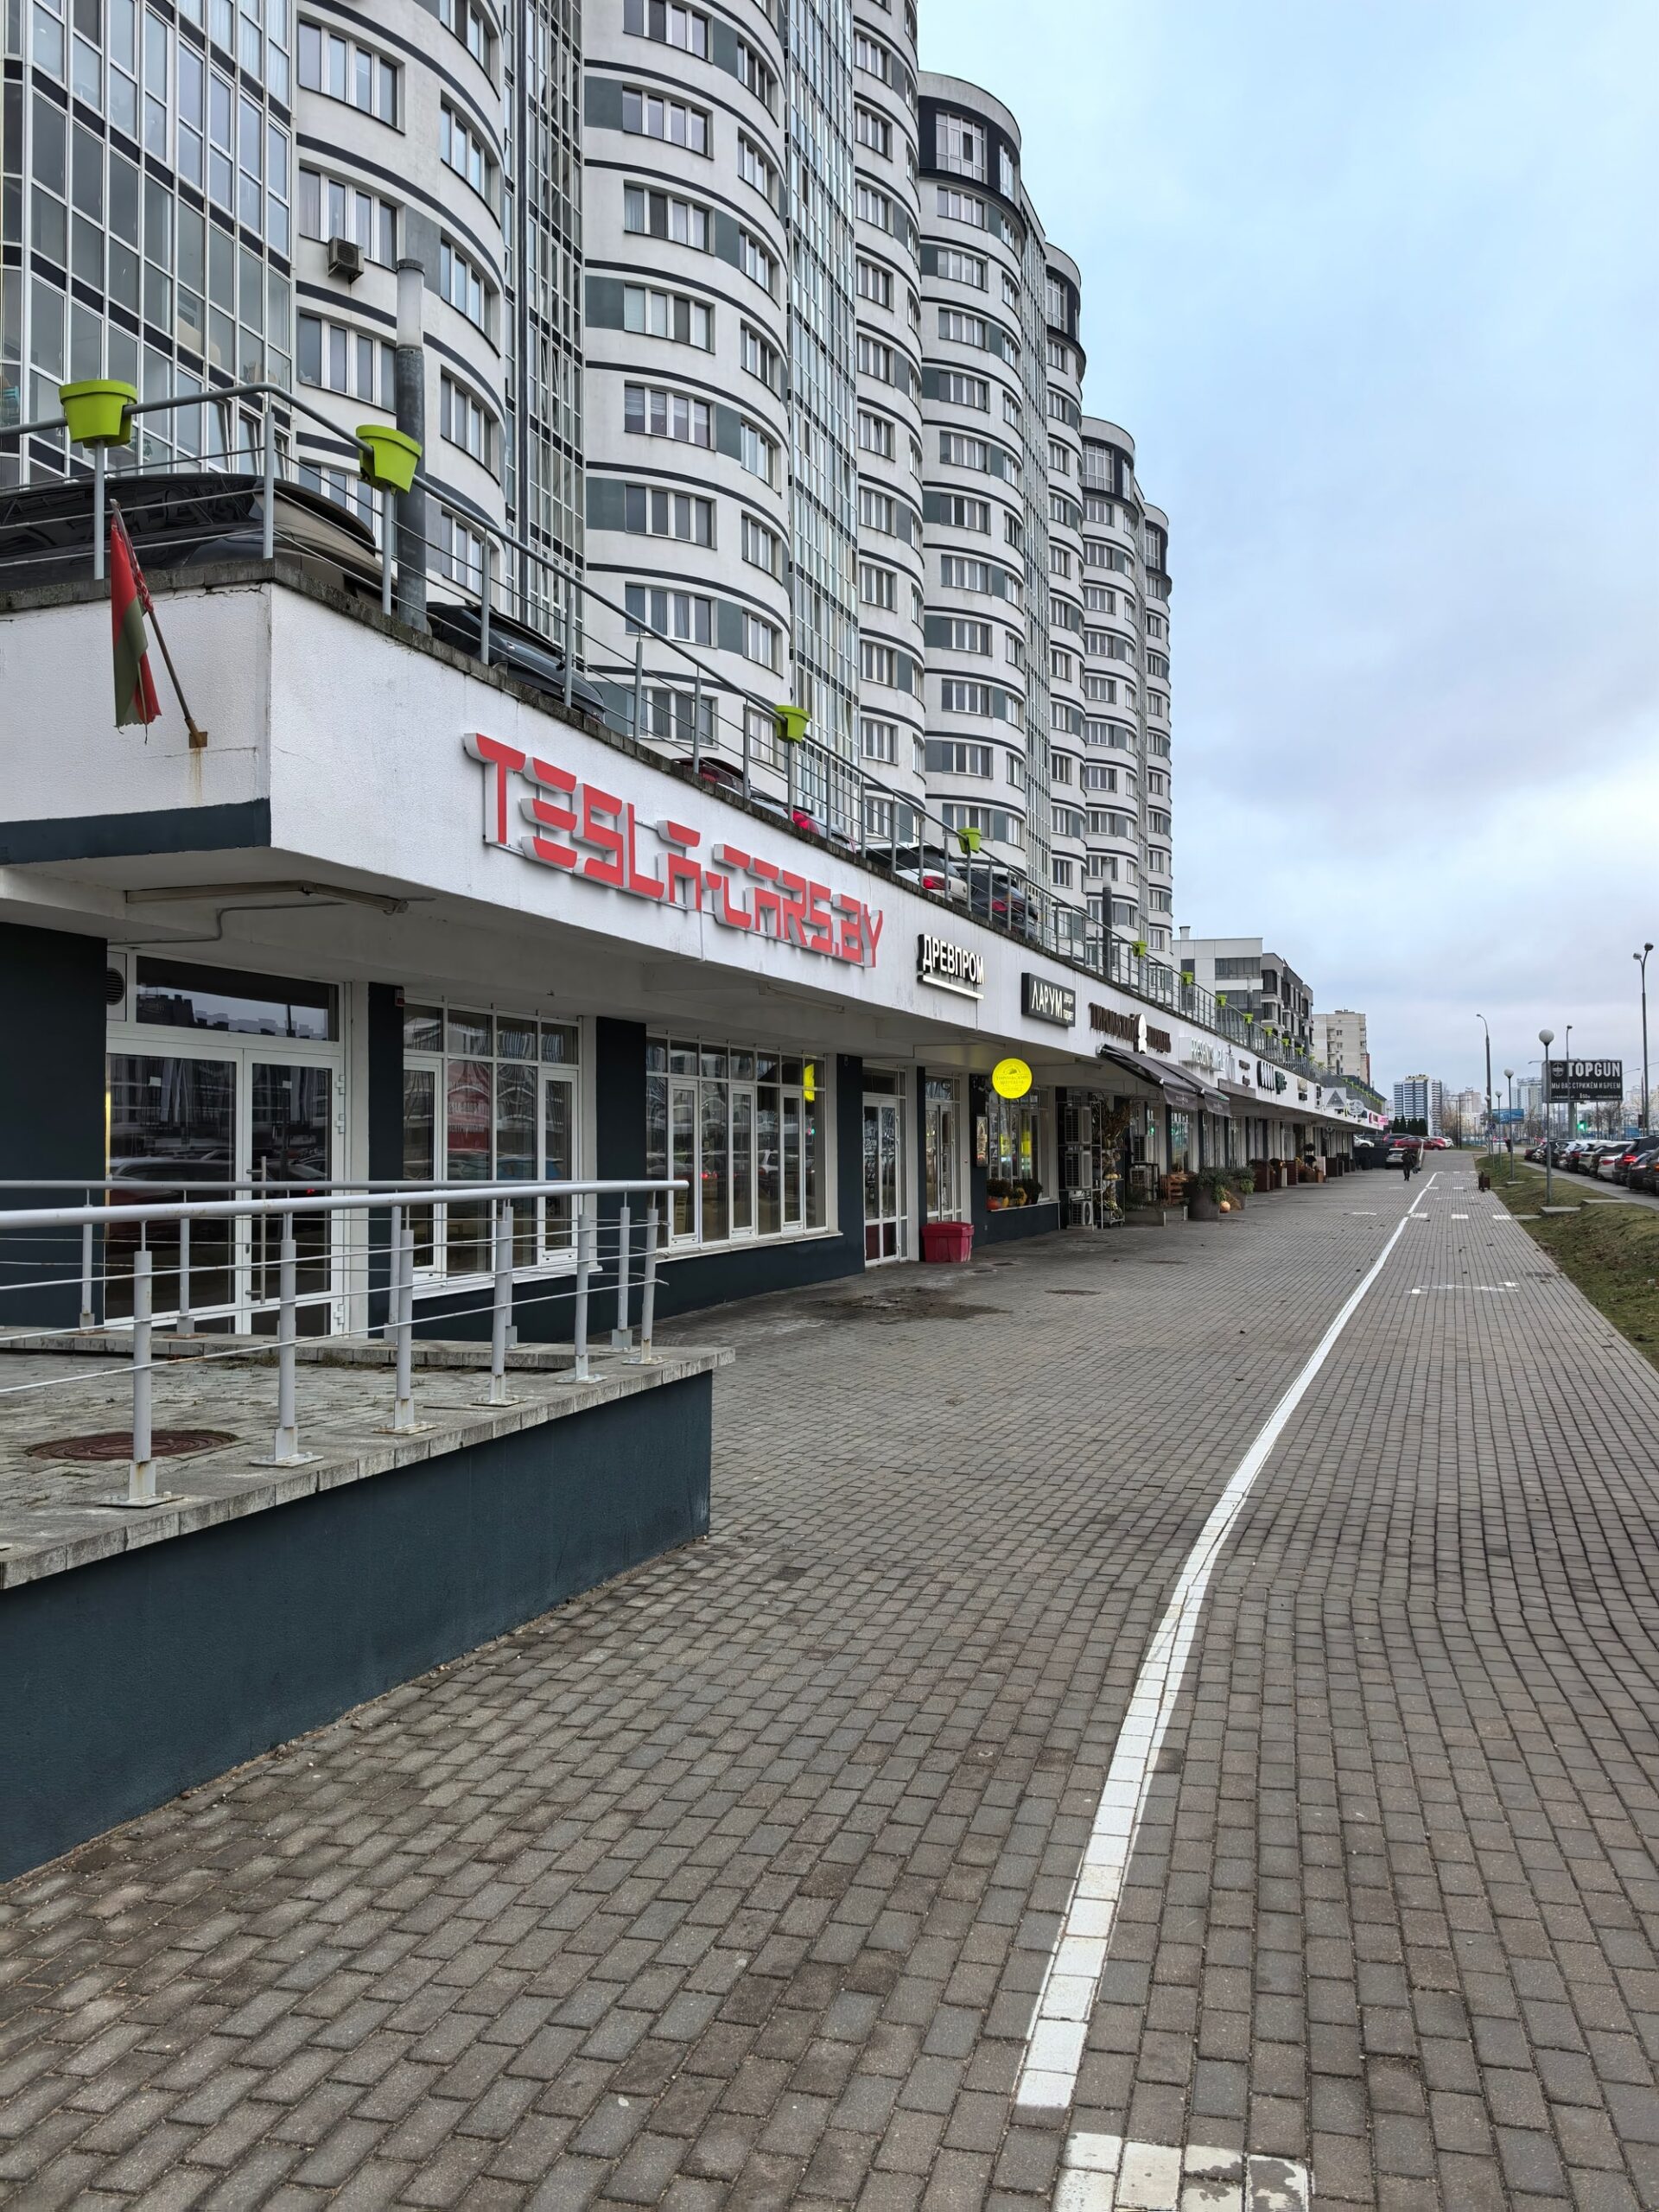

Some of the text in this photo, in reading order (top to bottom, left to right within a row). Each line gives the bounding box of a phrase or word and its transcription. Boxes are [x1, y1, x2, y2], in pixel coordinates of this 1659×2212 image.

[467, 732, 883, 968] TESLA-CARS.BY
[923, 934, 984, 984] ДРЕВПРОМ
[1031, 981, 1062, 1018] ЛАРУМ
[1567, 1062, 1621, 1077] TOPGUN
